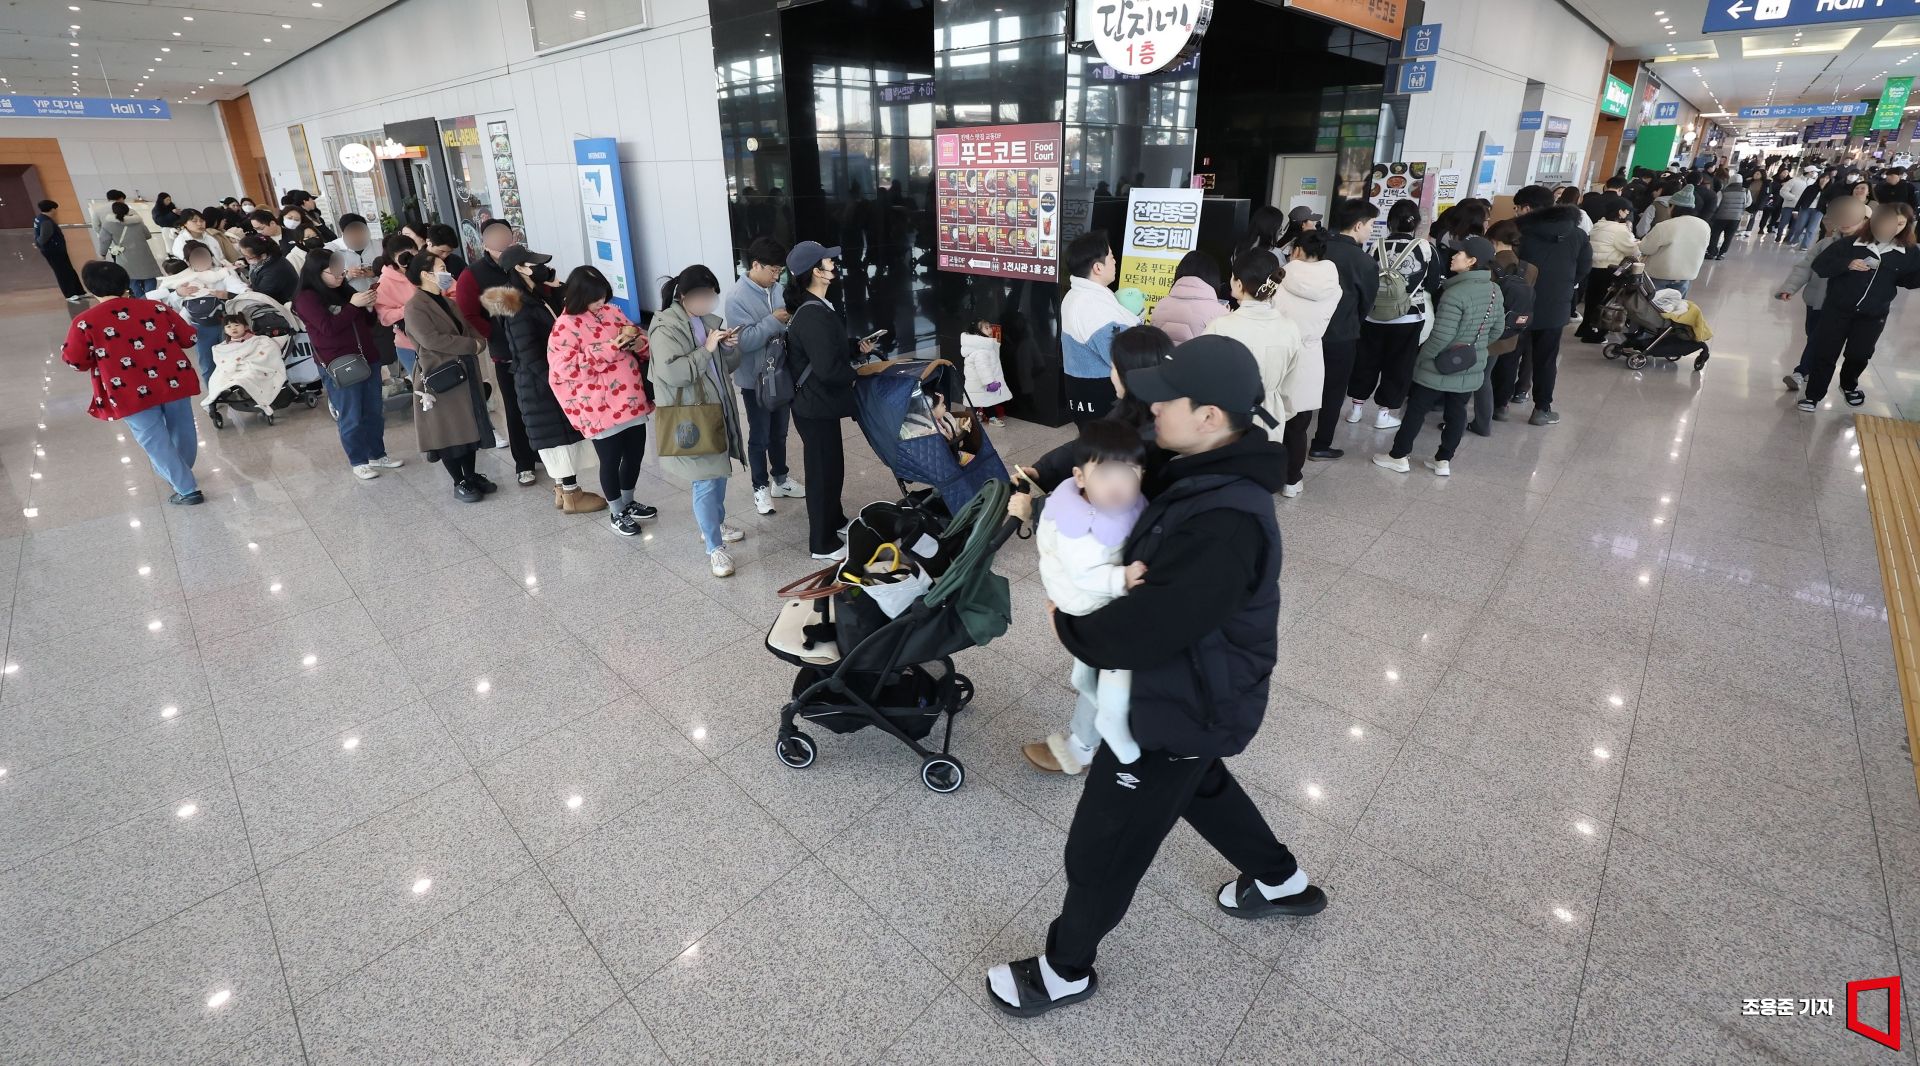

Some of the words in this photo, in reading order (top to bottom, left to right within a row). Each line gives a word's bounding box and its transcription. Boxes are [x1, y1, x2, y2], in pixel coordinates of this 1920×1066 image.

[1368, 0, 1397, 24] 푸드코트
[1126, 41, 1155, 66] 1층
[33, 99, 50, 108] VIP
[54, 100, 84, 110] 대기실
[111, 103, 135, 114] Hall
[138, 104, 144, 114] 1
[961, 141, 1028, 165] 푸드코트
[1035, 142, 1053, 151] Food
[1034, 152, 1054, 160] Court
[1383, 188, 1407, 198] 킨텍스
[1377, 199, 1397, 208] 푸드
[1133, 201, 1198, 224] 전망좋은
[1133, 226, 1191, 250] 2층카페
[1002, 261, 1028, 273] 1전시관
[1029, 264, 1041, 275] 1홀
[1043, 265, 1056, 276] 2층
[1136, 262, 1148, 273] 2층
[1151, 263, 1178, 274] 푸드코
[1124, 274, 1156, 286] 모든좌석
[291, 342, 314, 358] NI
